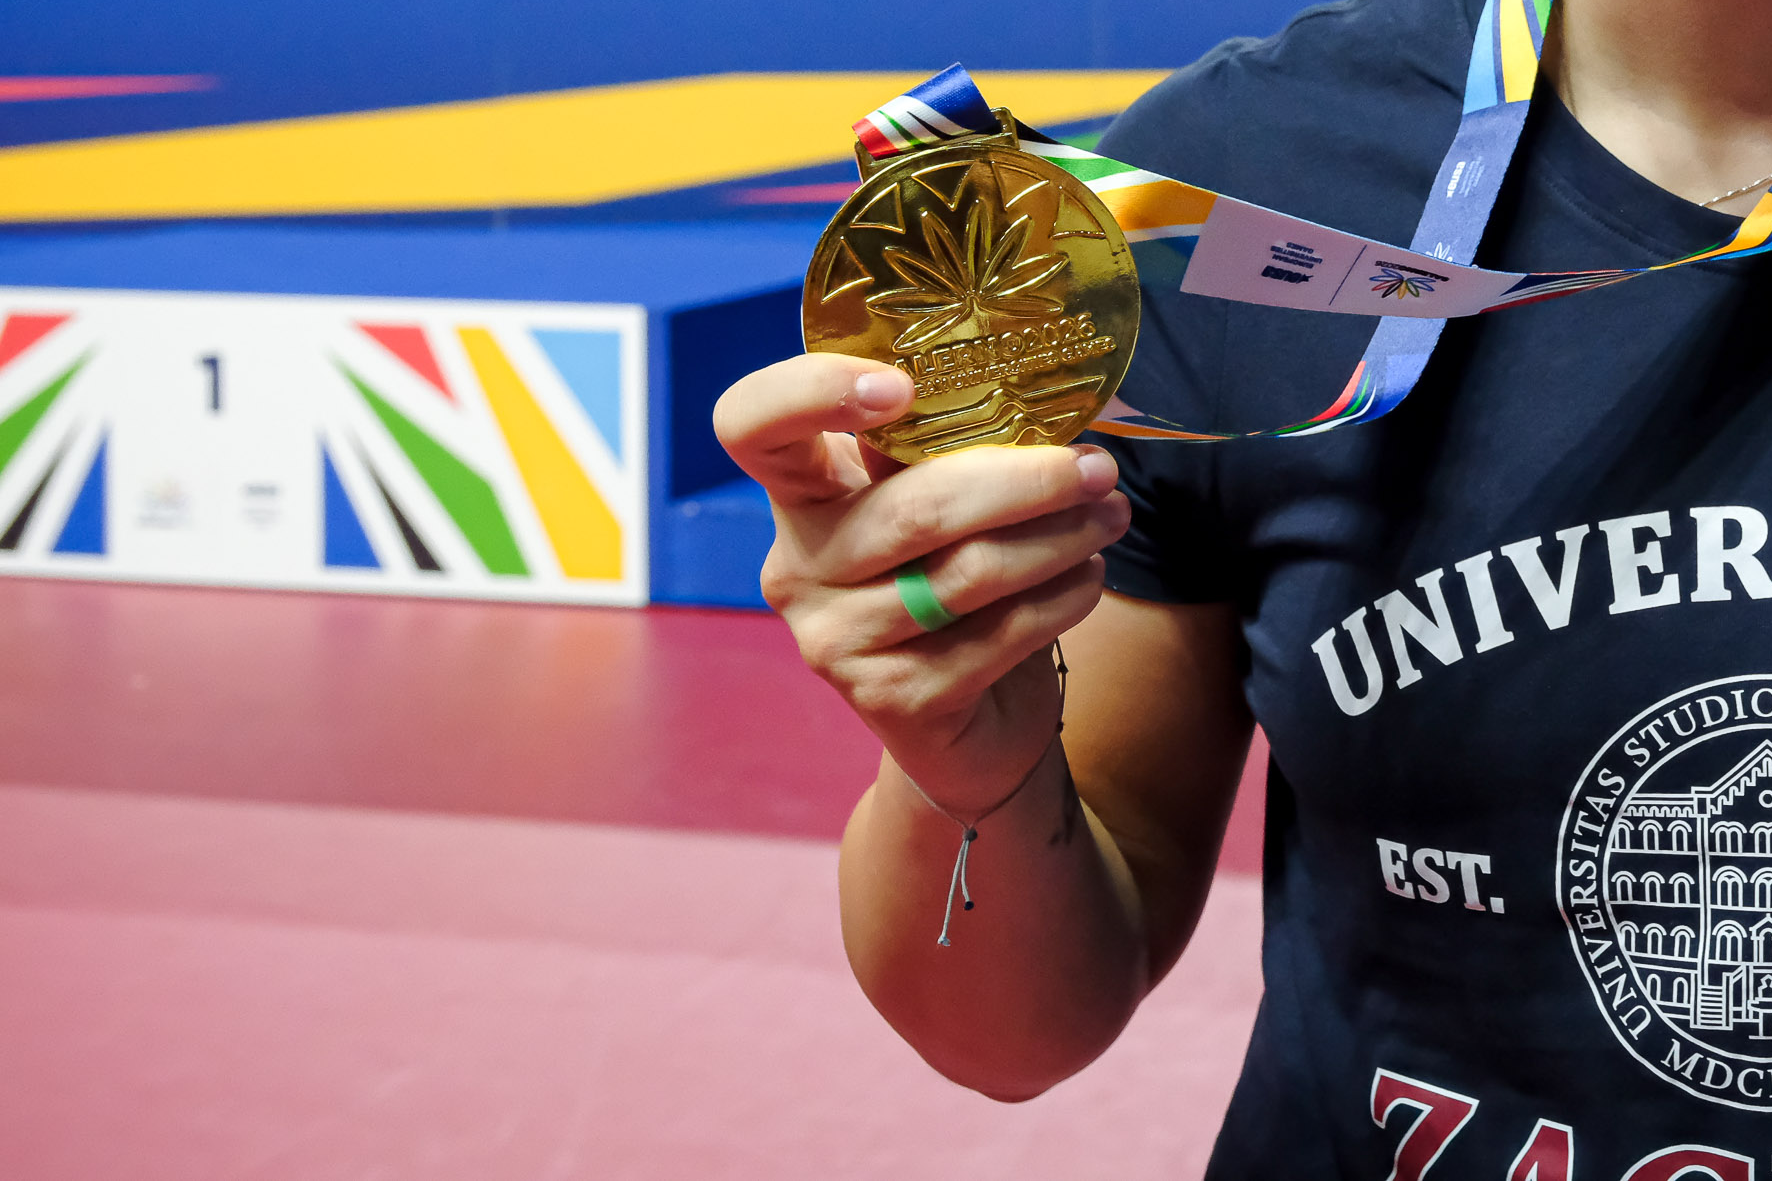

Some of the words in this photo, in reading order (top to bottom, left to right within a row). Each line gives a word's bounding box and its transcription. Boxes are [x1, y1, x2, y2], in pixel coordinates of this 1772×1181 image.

[199, 353, 221, 411] 1
[1375, 836, 1505, 915] EST.
[1568, 768, 1652, 1041] UNIVERSITAS
